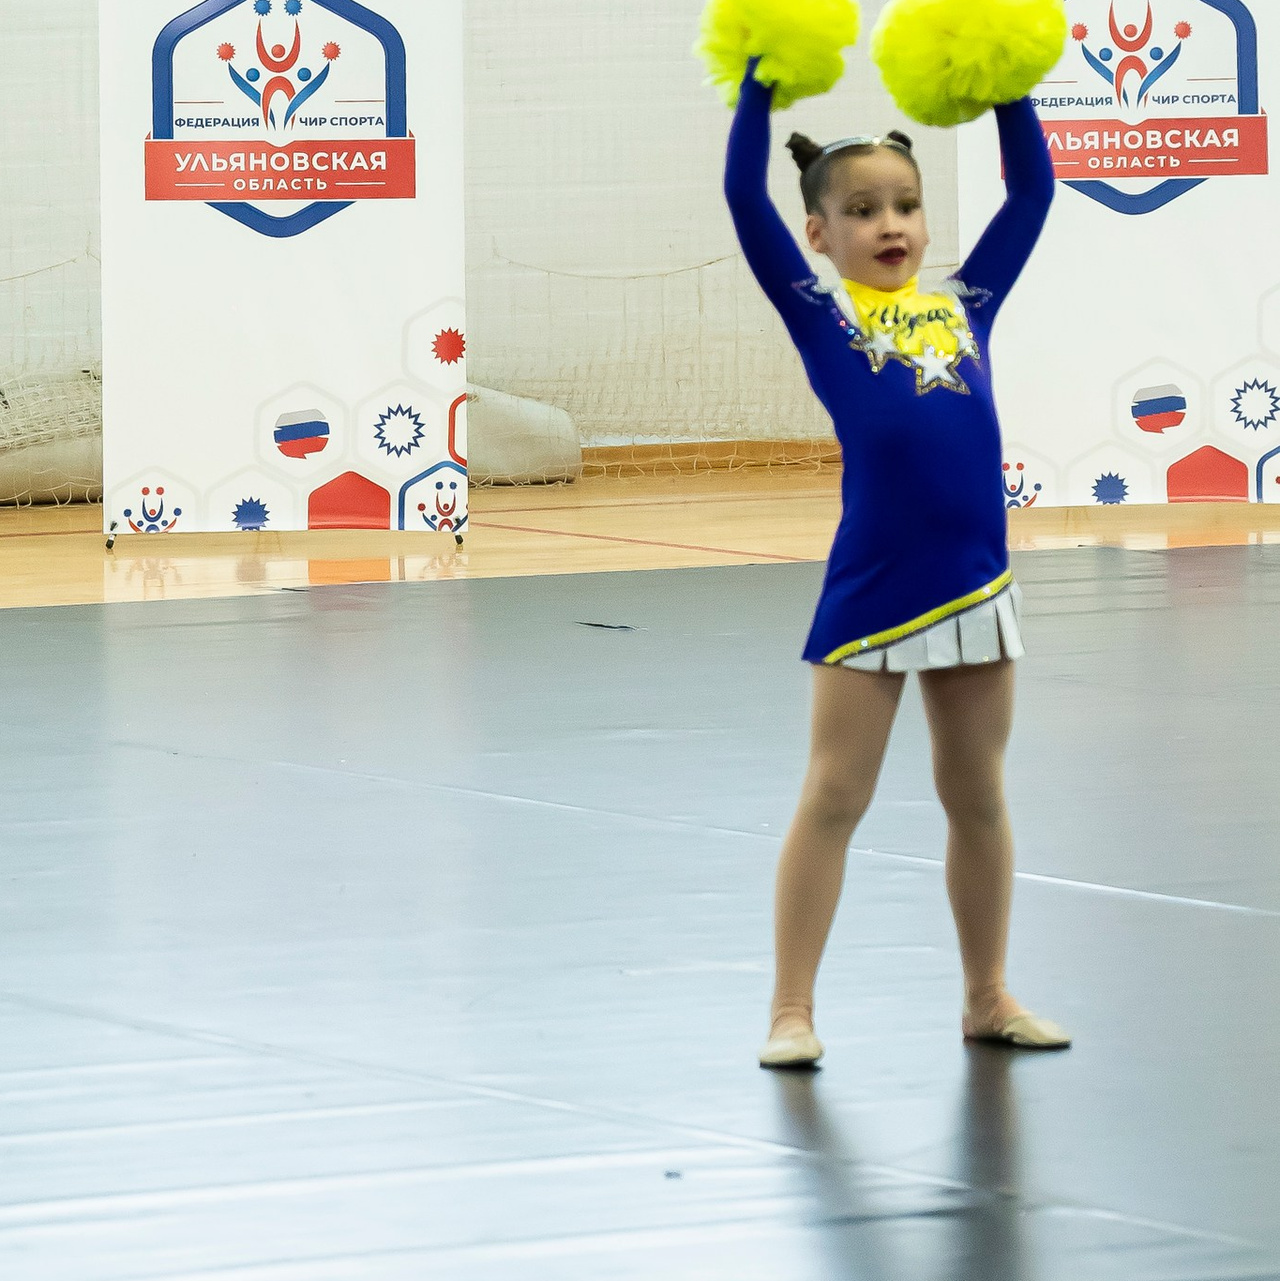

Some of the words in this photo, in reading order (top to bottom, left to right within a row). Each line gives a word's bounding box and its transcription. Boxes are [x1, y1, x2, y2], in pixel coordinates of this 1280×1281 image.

[1030, 96, 1113, 108] ФЕДЕРАЦИЯ
[1151, 95, 1180, 105] ЧИР
[1182, 93, 1237, 105] СПОРТА
[174, 116, 260, 130] ФЕДЕРАЦИЯ
[298, 116, 328, 127] ЧИР
[329, 115, 385, 127] СПОРТА
[1044, 128, 1240, 151] ЛЬЯНОВСКАЯ
[174, 150, 387, 173] УЛЬЯНОВСКАЯ
[1087, 154, 1181, 170] ОБЛАСТЬ
[232, 177, 328, 192] ОБЛАСТЬ
